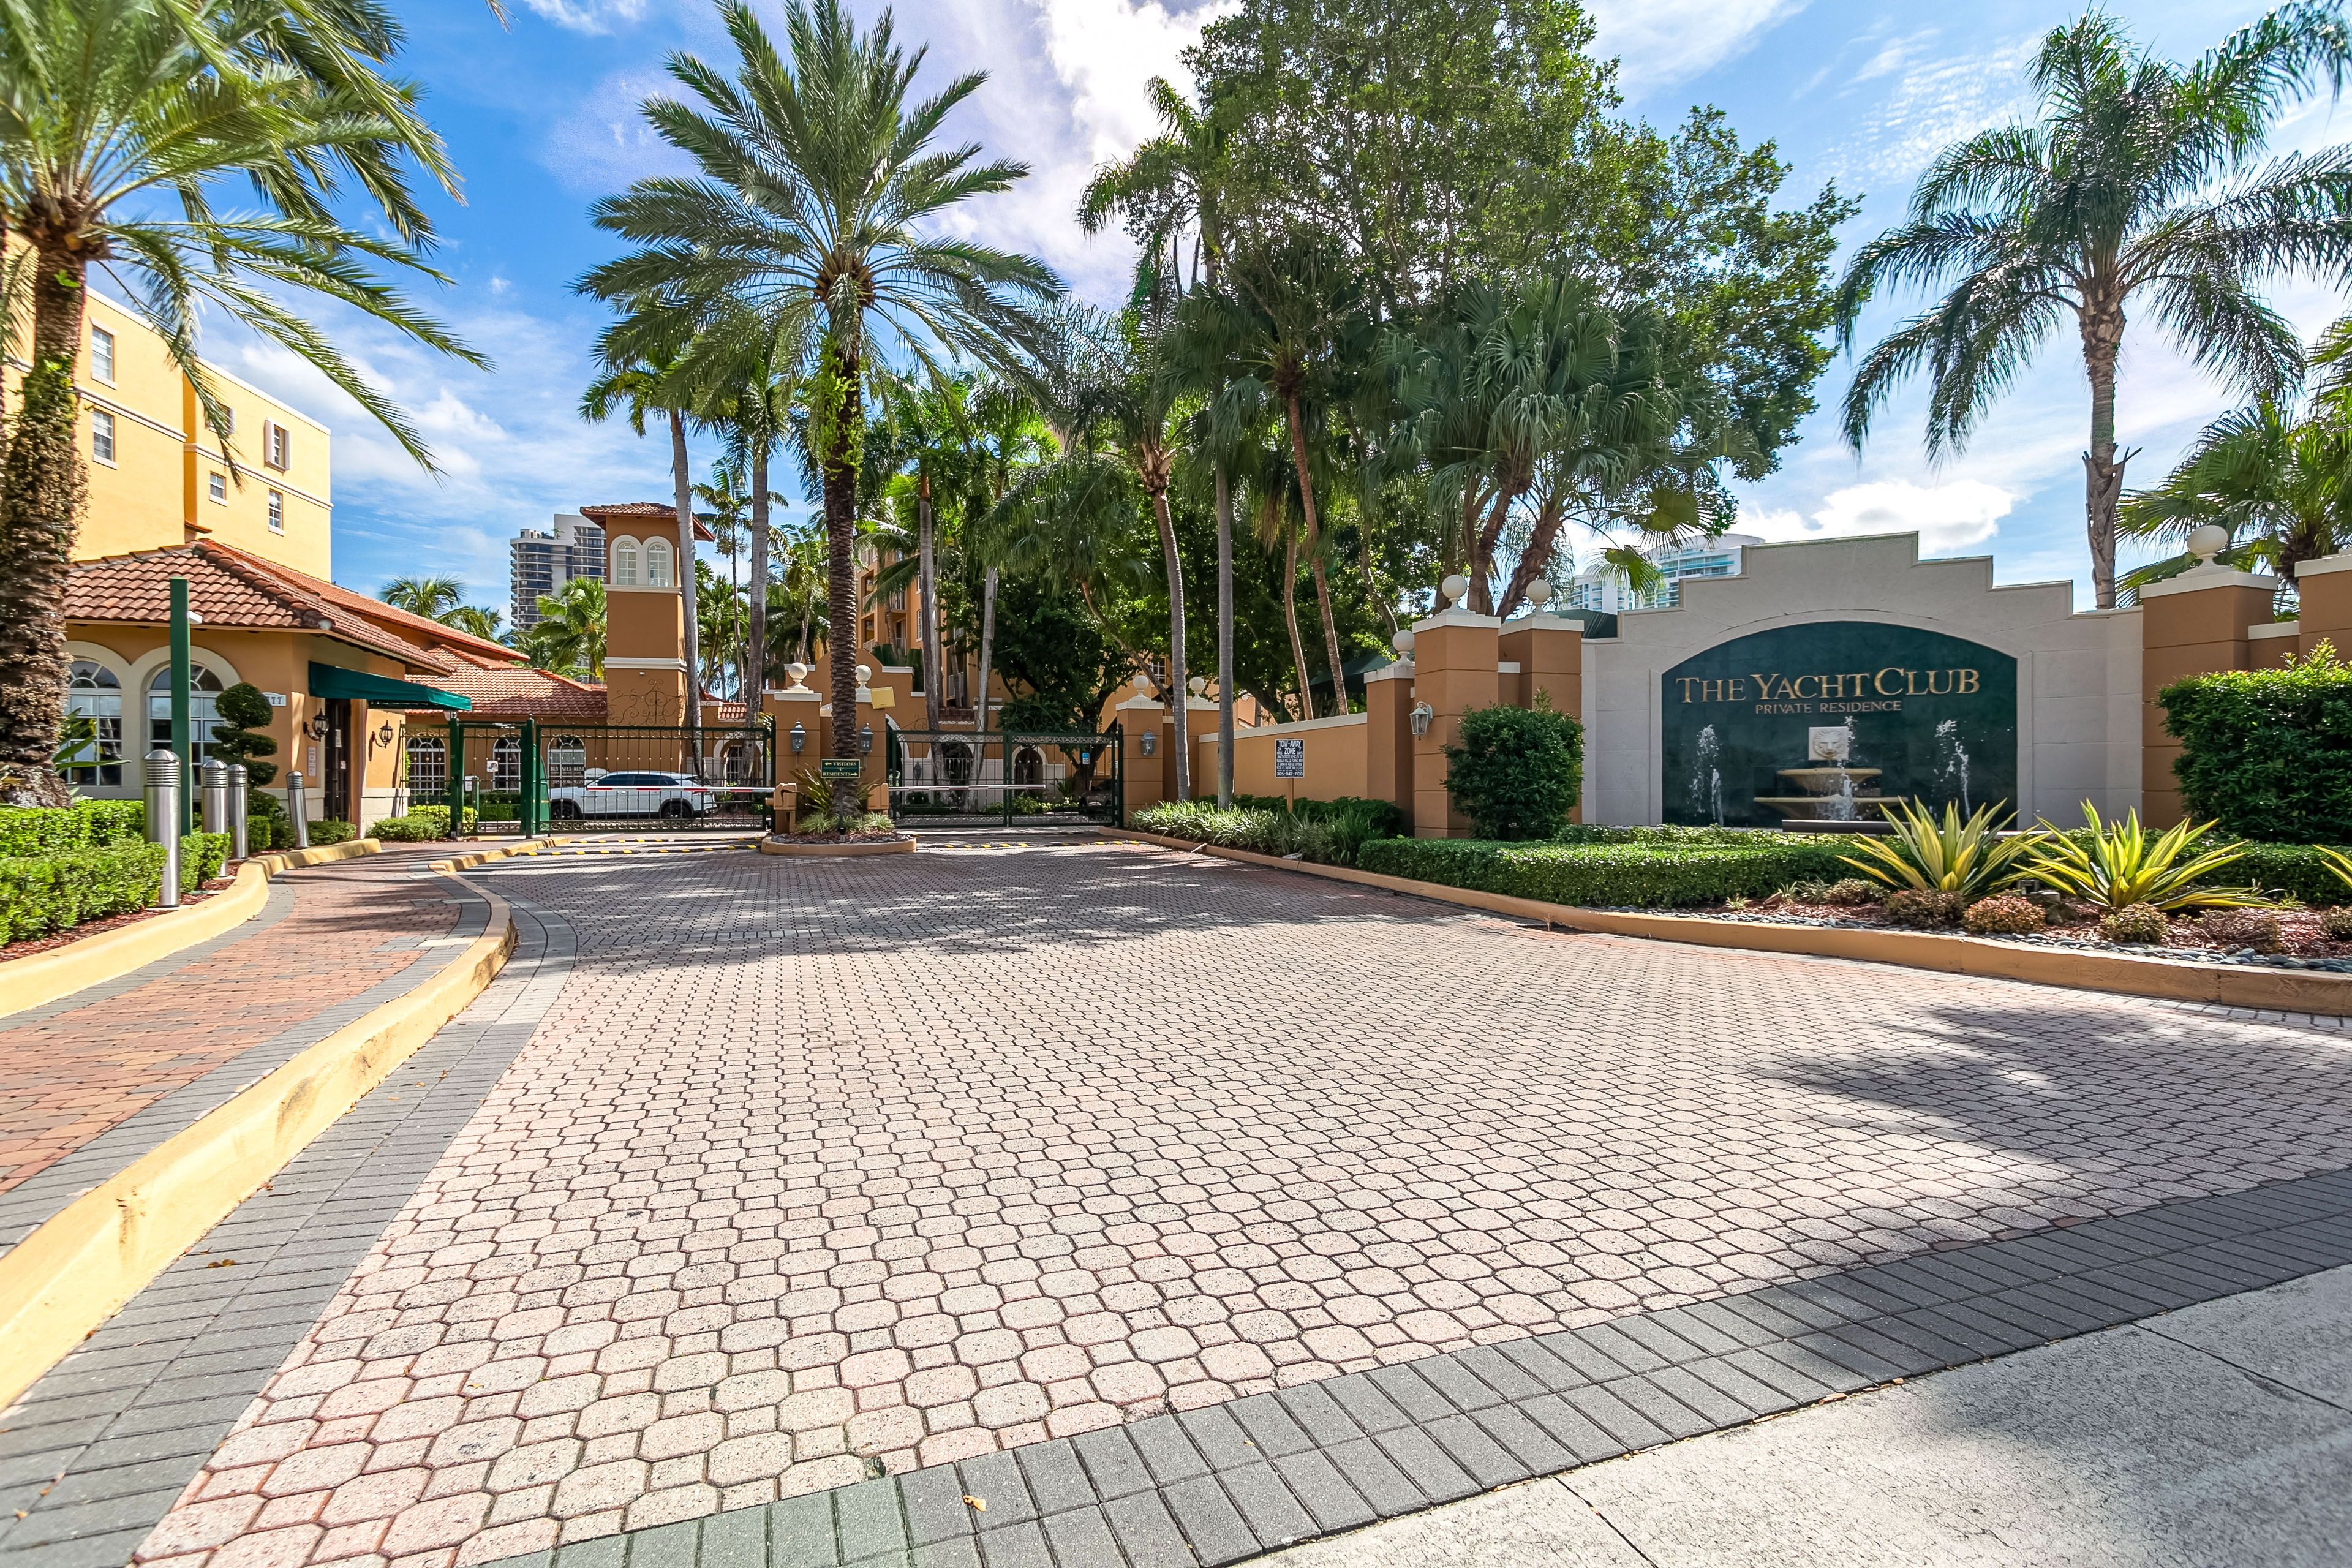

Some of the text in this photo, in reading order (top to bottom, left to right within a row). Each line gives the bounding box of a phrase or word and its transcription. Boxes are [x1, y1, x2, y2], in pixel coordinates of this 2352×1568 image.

[1675, 667, 1980, 703] THE YACHT CLUB
[1755, 700, 1902, 714] PRIVATE RESIDENCE
